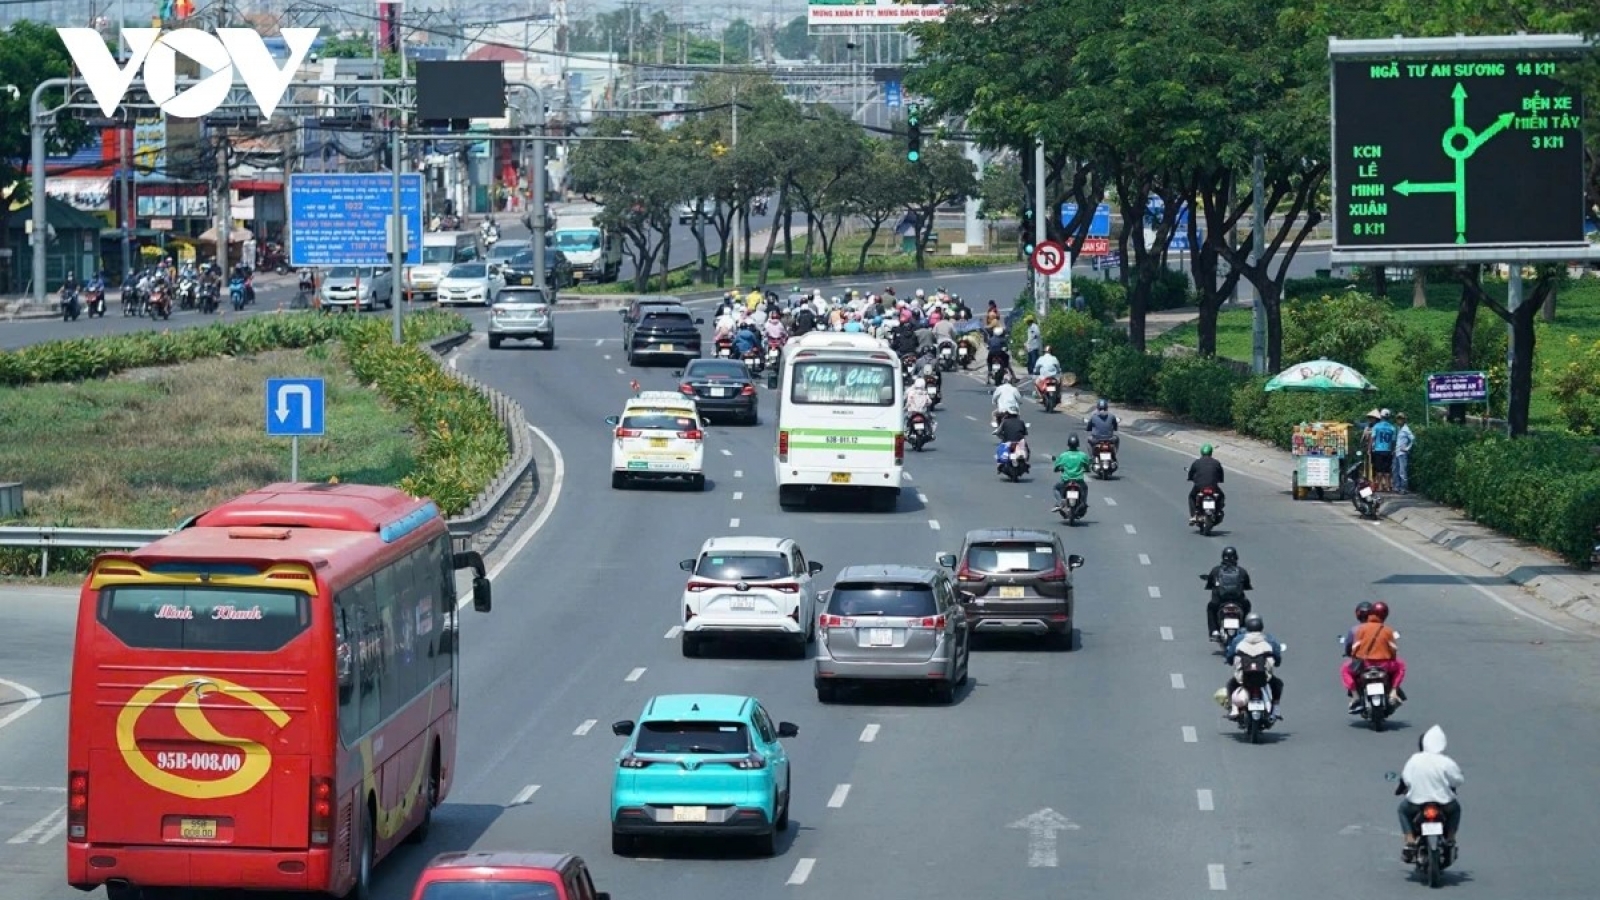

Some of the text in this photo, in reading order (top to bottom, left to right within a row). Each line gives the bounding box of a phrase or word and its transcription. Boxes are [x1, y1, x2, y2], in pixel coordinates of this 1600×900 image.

[1370, 62, 1556, 78] NGÃ TƯ AN SƯƠNG 14 KM
[1523, 90, 1572, 110] BẾN XE
[1552, 113, 1580, 129] TÂY
[1532, 136, 1564, 148] 3 KM
[1353, 146, 1381, 157] KCN
[1359, 162, 1378, 177] LÊ
[1352, 184, 1384, 196] MINH
[1349, 202, 1387, 215] XUÂN
[1353, 223, 1385, 235] 8 KM
[154, 604, 193, 620] Minh
[157, 751, 241, 771] 95B-008.00
